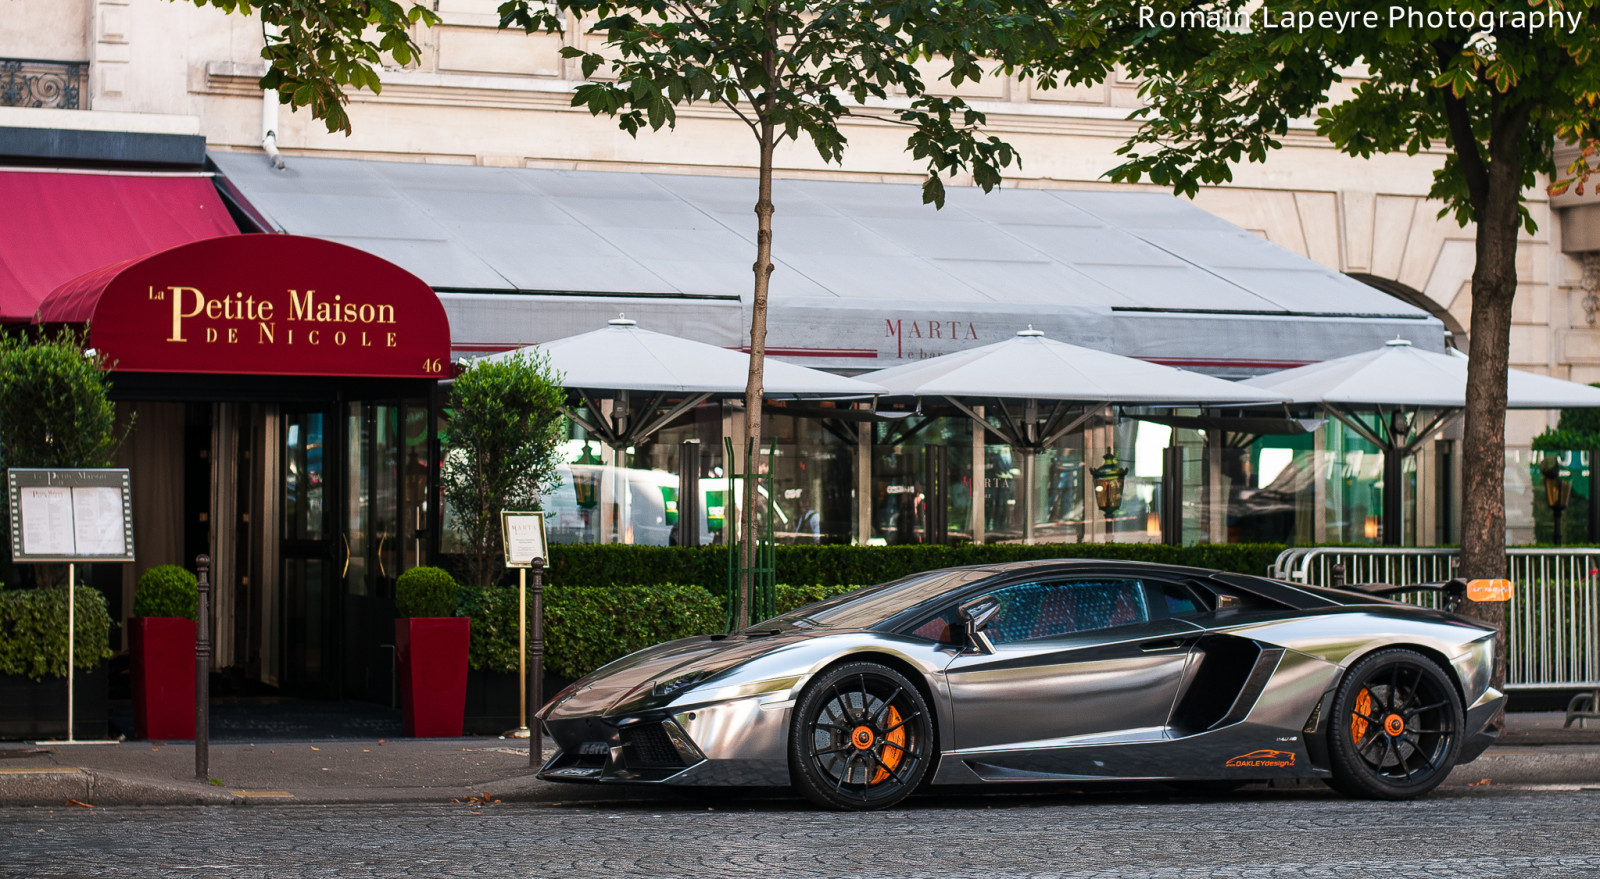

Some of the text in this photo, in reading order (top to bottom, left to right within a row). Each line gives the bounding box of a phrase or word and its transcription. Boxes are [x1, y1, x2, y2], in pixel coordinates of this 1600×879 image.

[149, 285, 396, 343] La Petite Maison
[206, 322, 397, 347] DE NICOLE
[885, 319, 978, 358] MARTA
[422, 358, 442, 373] 46
[963, 476, 1009, 498] MRTA
